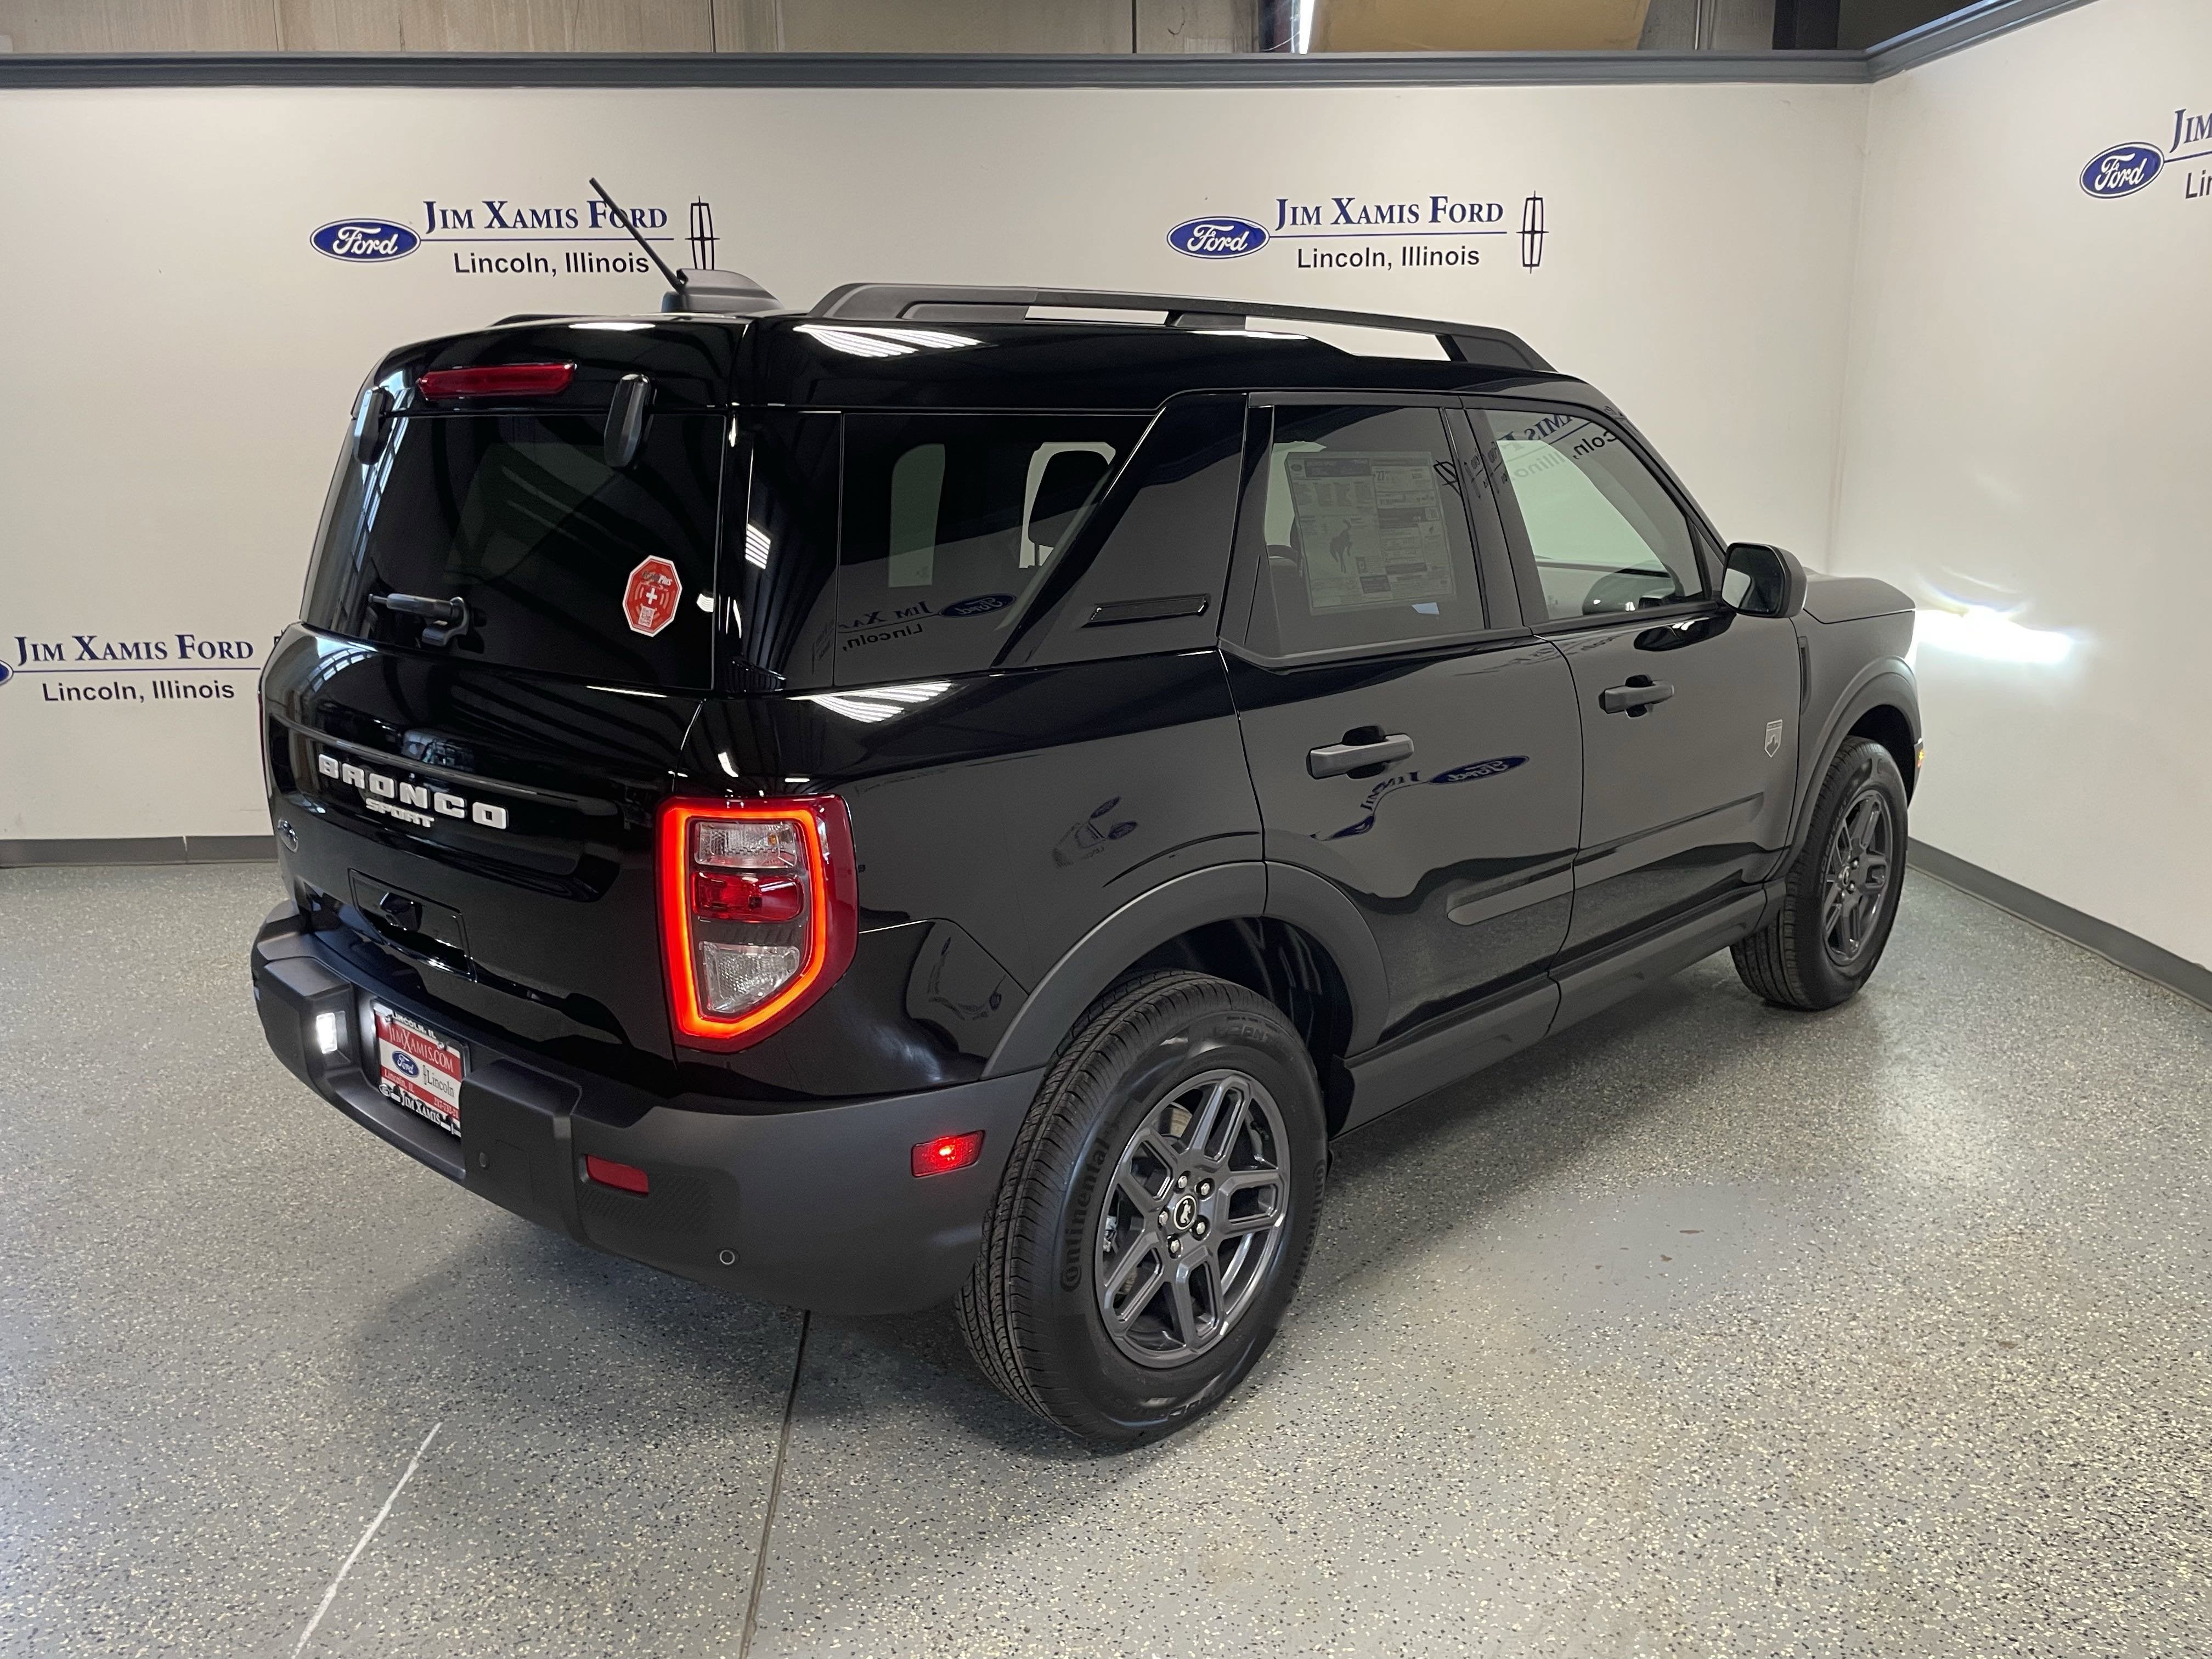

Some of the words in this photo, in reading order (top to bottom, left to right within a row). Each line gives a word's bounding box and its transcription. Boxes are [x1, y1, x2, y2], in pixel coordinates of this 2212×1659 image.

[2095, 153, 2148, 191] Ford
[423, 201, 475, 234] JIM
[482, 201, 578, 229] XAMIS
[587, 200, 668, 229] FORD
[1275, 199, 1322, 231] JIM
[1330, 198, 1419, 225] XAMIS
[1429, 196, 1503, 223] FORD
[454, 252, 556, 277] Lincoln,
[566, 252, 649, 273] Illinois
[1298, 247, 1391, 270] Lincoln,
[1402, 246, 1479, 266] Illinois
[14, 636, 65, 666] JIM
[72, 635, 167, 661] XAMIS
[175, 635, 253, 659] FORD
[42, 682, 144, 703] Lincoln,
[153, 680, 234, 699] Illinois
[318, 754, 508, 830] BRONCO
[365, 798, 435, 828] SPORT
[389, 1026, 454, 1073] JIMXAMIS.COM
[426, 1069, 455, 1098] Lincoln
[400, 1091, 415, 1111] JIM
[416, 1098, 441, 1125] XAMIS
